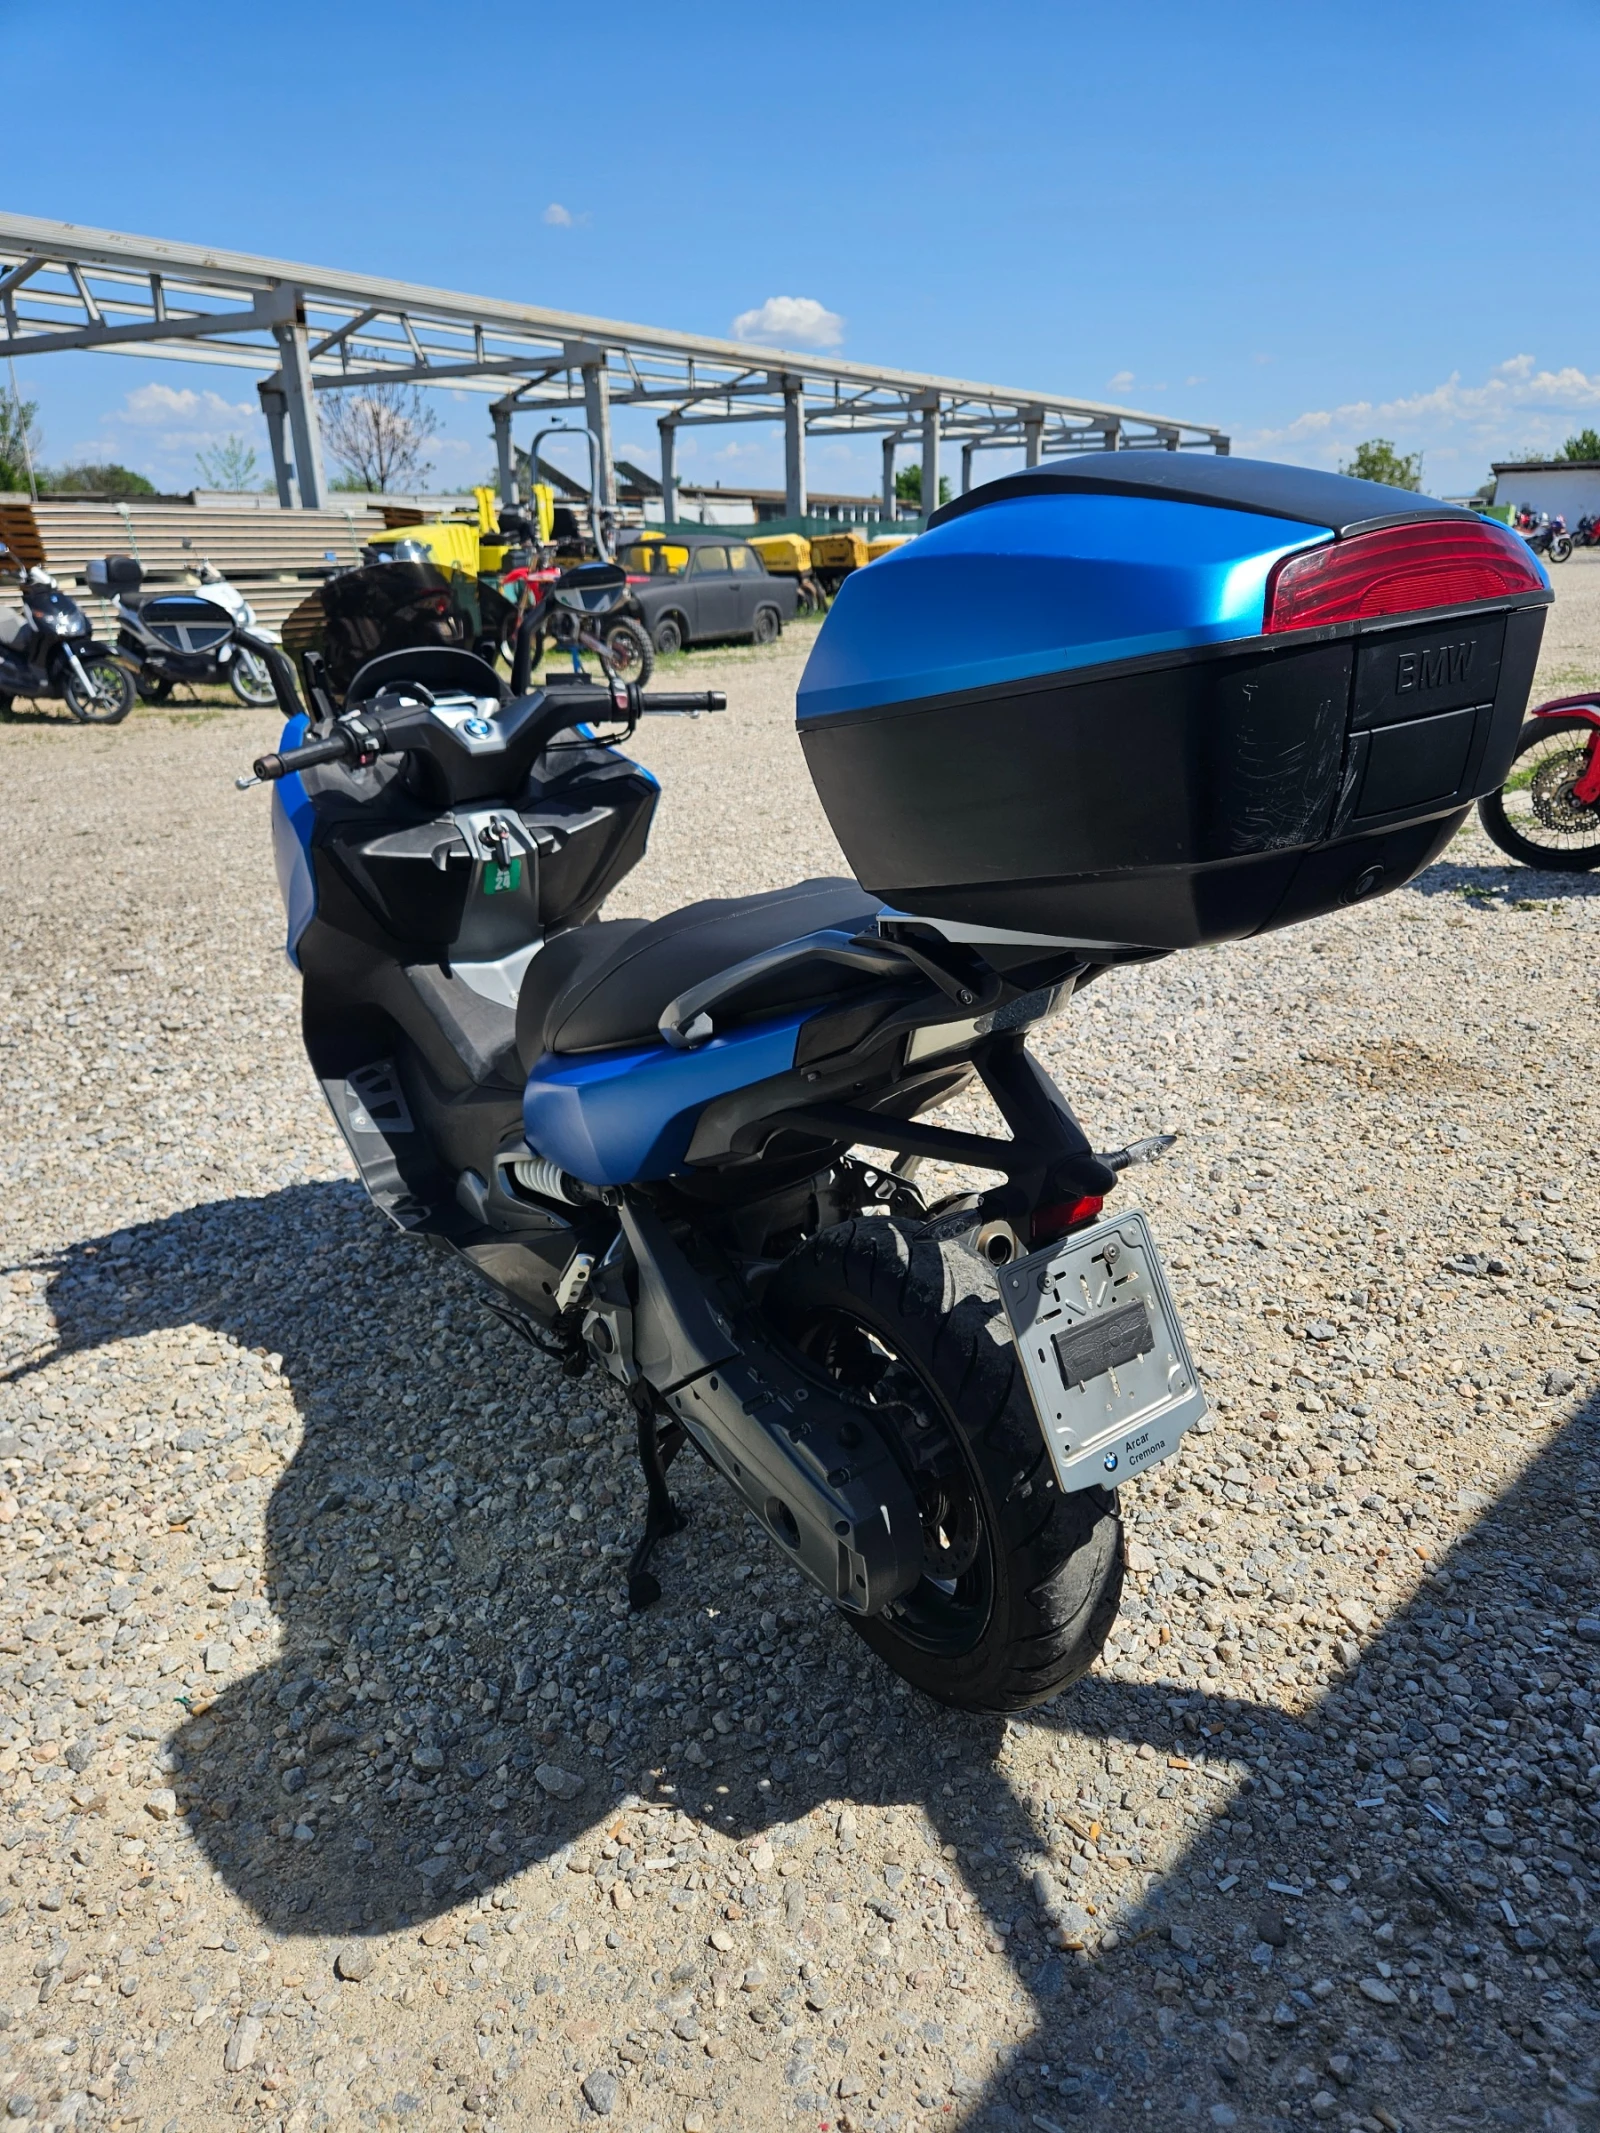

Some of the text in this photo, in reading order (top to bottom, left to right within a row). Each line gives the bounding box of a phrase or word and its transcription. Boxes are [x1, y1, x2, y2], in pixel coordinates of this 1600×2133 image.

[1395, 641, 1477, 695] BMW
[1125, 1432, 1149, 1453] Arcar
[1129, 1440, 1166, 1466] Cremona
